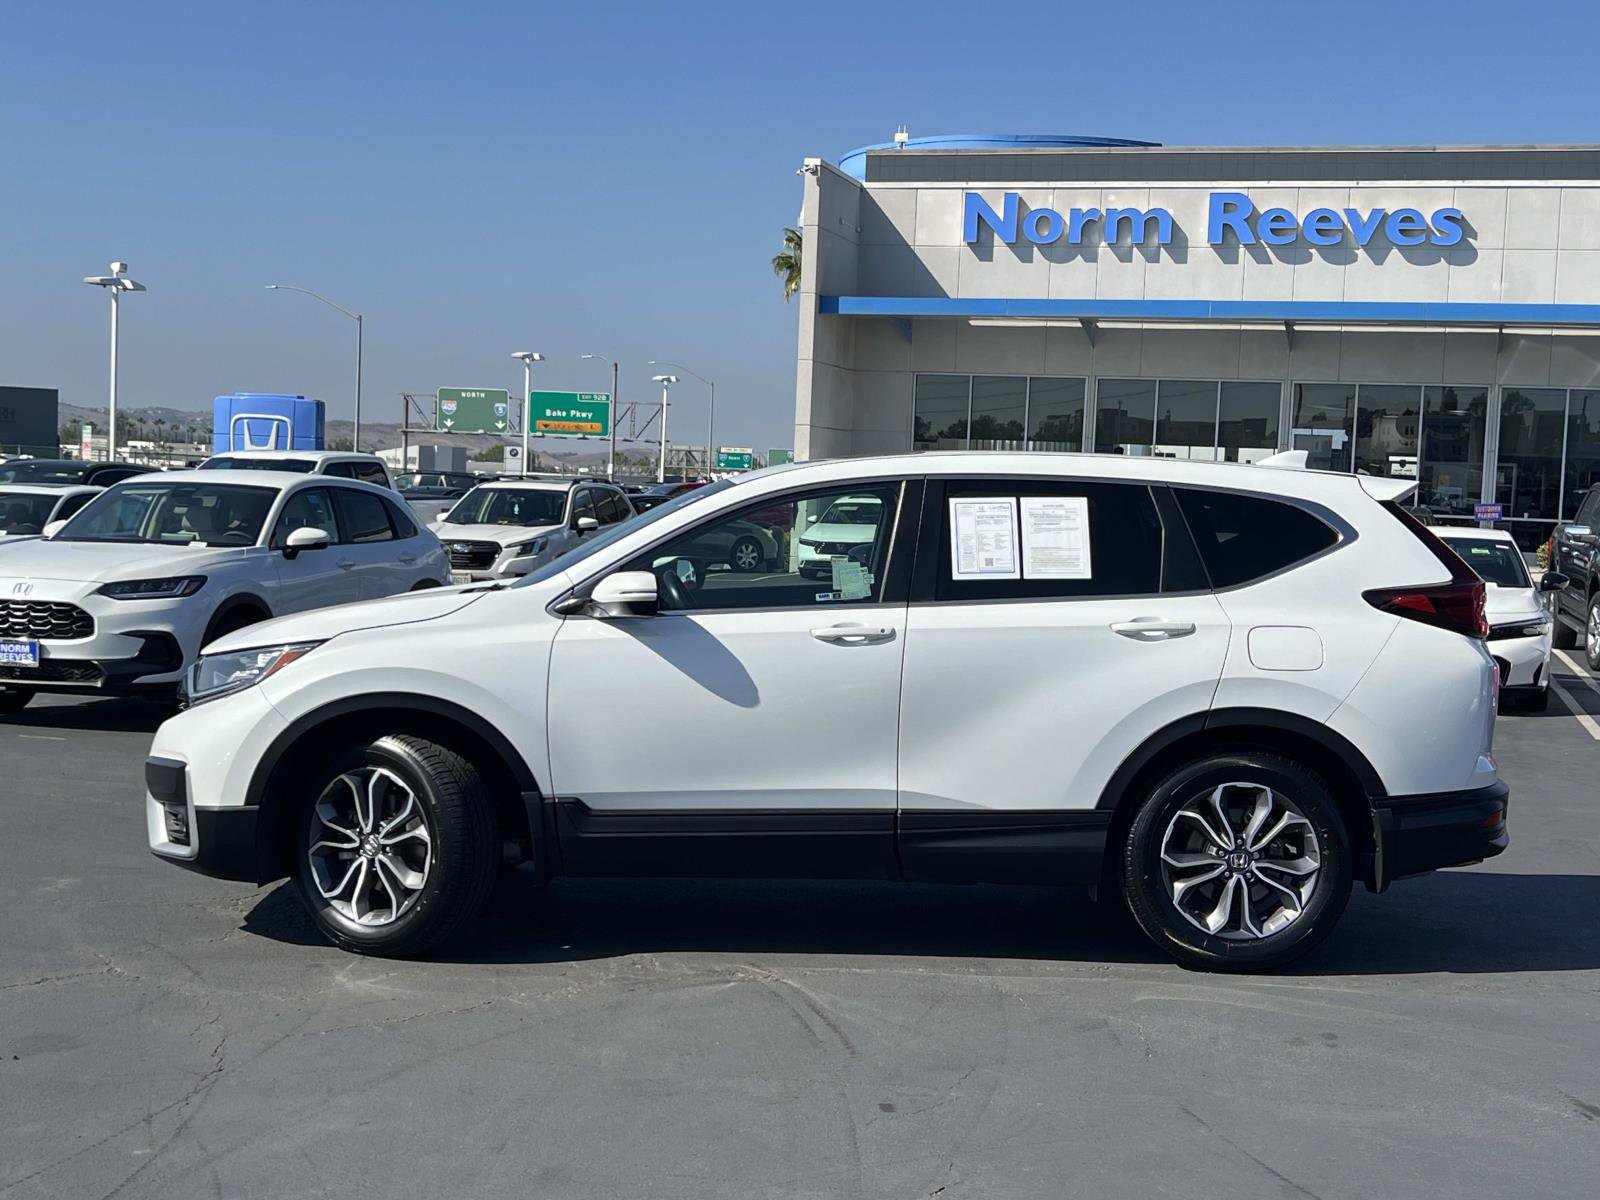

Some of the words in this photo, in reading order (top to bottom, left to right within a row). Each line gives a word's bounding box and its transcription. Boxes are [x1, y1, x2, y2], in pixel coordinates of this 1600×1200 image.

[963, 192, 1173, 246] Norm
[1208, 192, 1464, 246] Reeves
[545, 409, 567, 417] Bake
[570, 410, 593, 420] Pkwy
[0, 643, 30, 653] NORM
